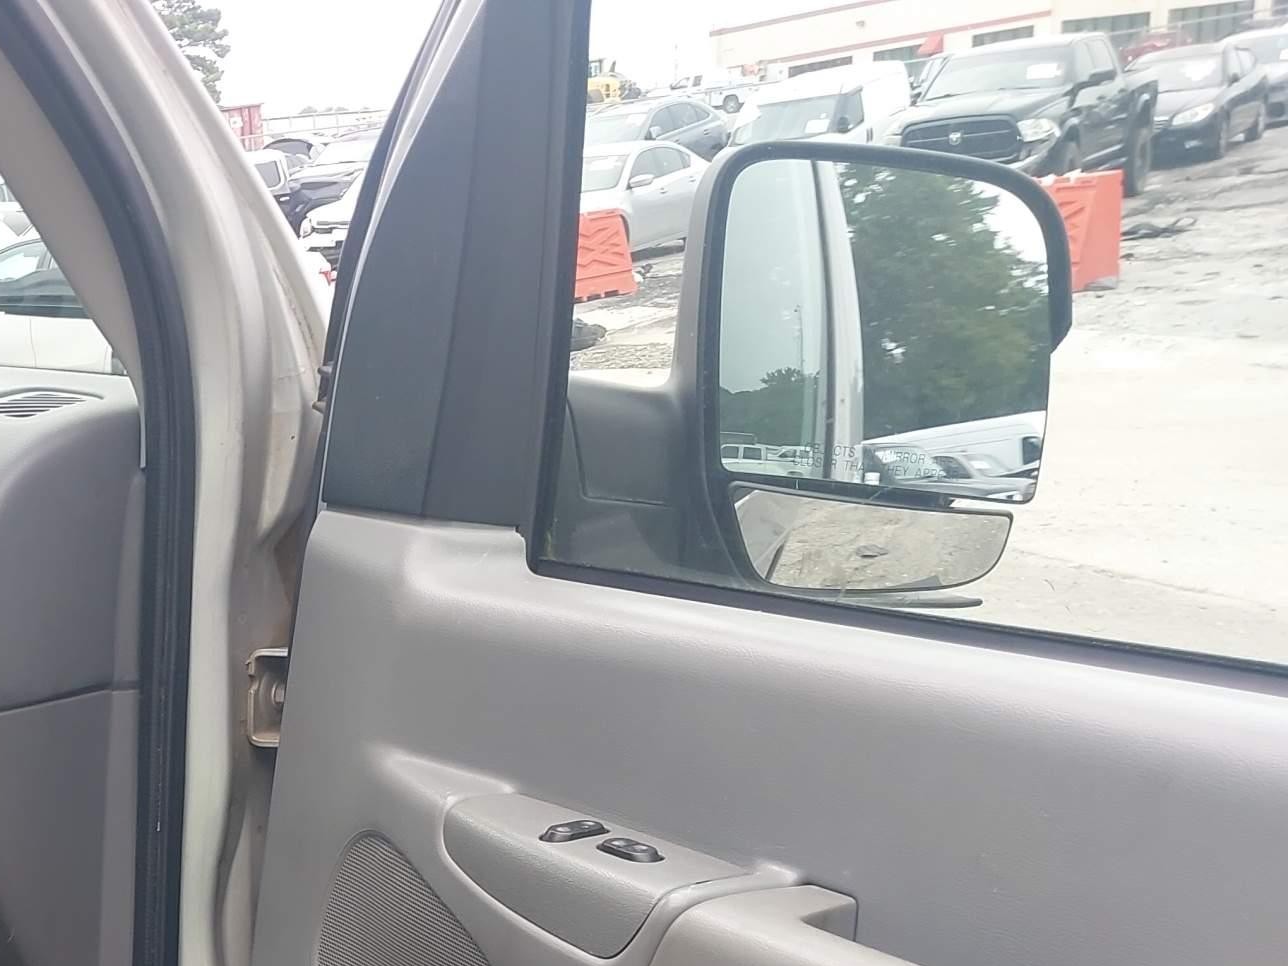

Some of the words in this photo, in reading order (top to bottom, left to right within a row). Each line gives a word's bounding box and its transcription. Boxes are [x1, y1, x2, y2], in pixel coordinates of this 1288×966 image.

[793, 454, 838, 469] CLOSR
[842, 458, 870, 472] THA
[805, 441, 857, 458] OBCTS
[880, 449, 926, 465] RROR
